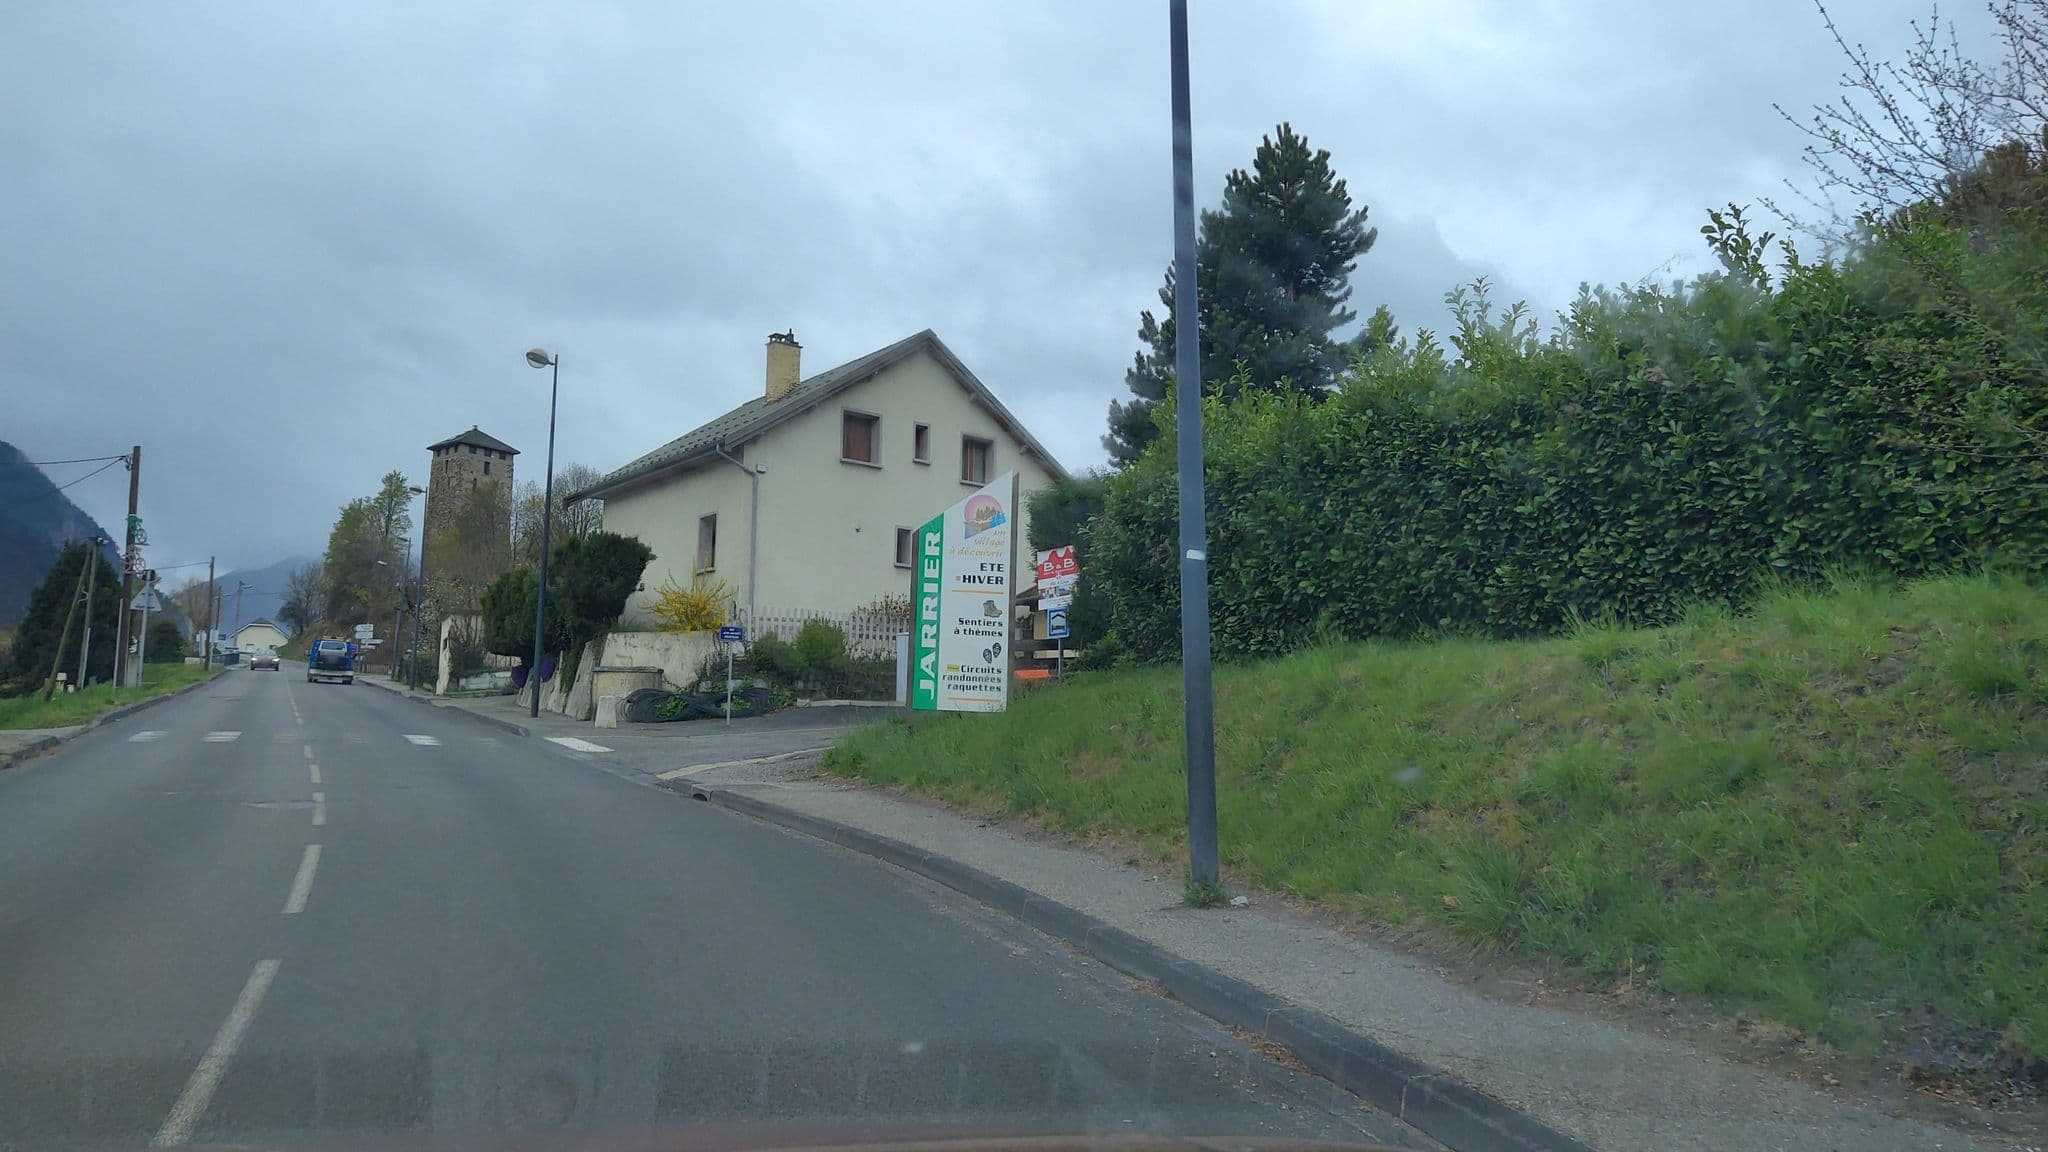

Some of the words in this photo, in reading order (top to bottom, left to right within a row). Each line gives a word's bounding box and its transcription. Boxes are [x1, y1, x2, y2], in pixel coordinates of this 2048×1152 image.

[980, 562, 1005, 573] ETE
[962, 574, 1004, 585] HIVER
[919, 530, 942, 700] JARRIER
[958, 617, 1003, 628] Sentiers
[954, 626, 960, 635] à
[963, 627, 1003, 637] thèmes
[960, 664, 1002, 675] Circuits
[942, 674, 1002, 683] randonnées
[947, 683, 1001, 692] raquettes
